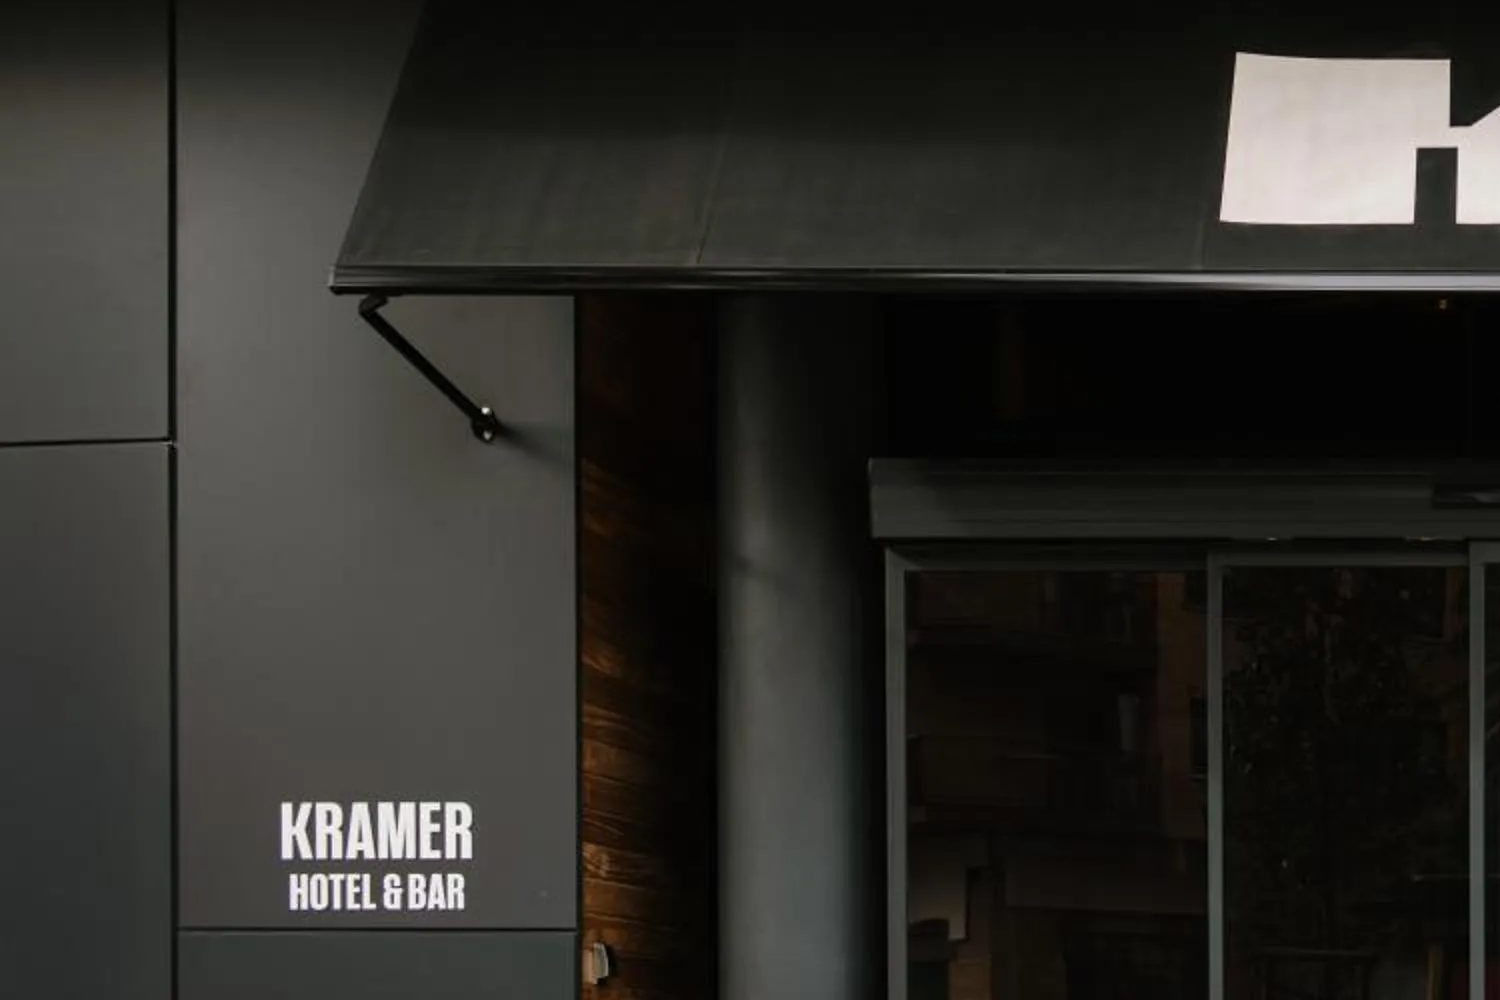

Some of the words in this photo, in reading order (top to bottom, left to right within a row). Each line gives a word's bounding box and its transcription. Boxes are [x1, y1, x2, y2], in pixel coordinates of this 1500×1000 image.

[280, 801, 474, 860] KRAMER
[289, 873, 377, 911] HOTEL
[383, 873, 403, 911] &
[407, 873, 466, 911] BAR
